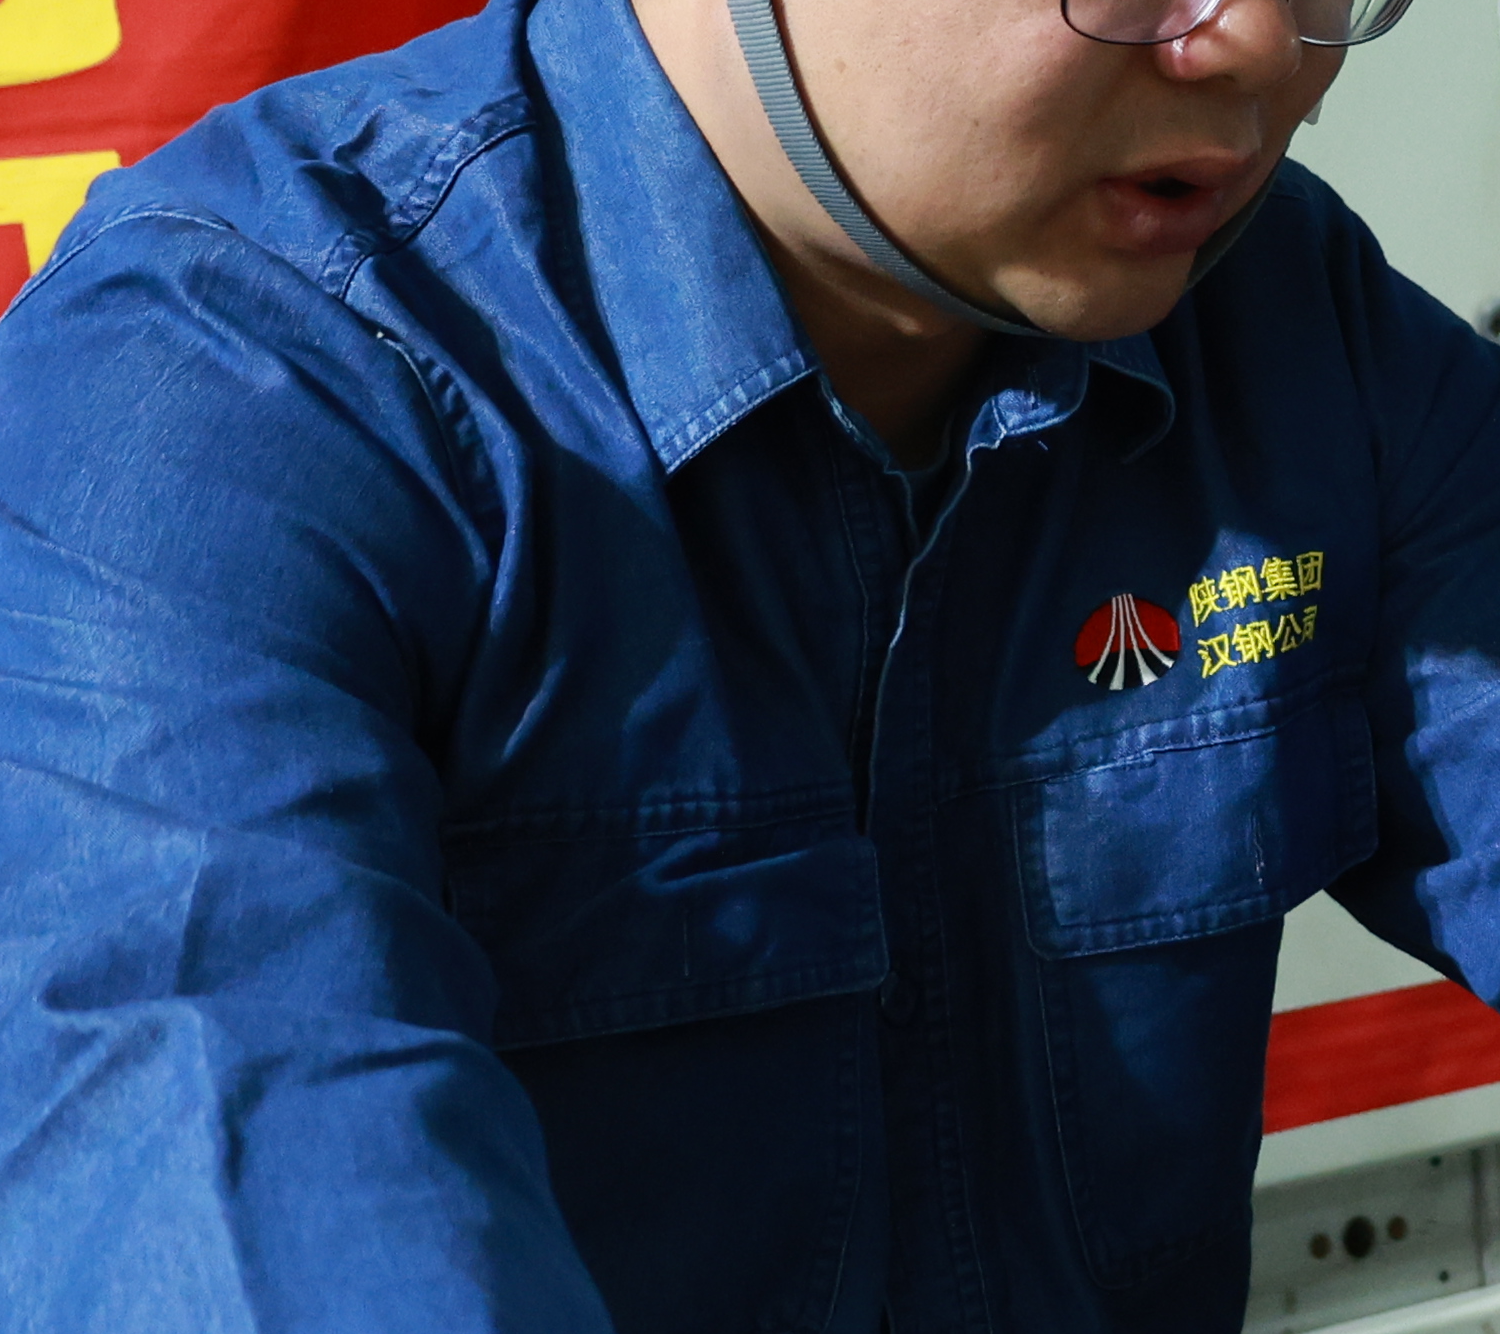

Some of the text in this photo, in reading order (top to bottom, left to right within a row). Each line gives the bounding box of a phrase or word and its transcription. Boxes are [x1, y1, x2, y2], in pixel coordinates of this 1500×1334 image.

[1189, 551, 1324, 628] 陕钢集团
[1197, 604, 1318, 679] 汉钢公司
